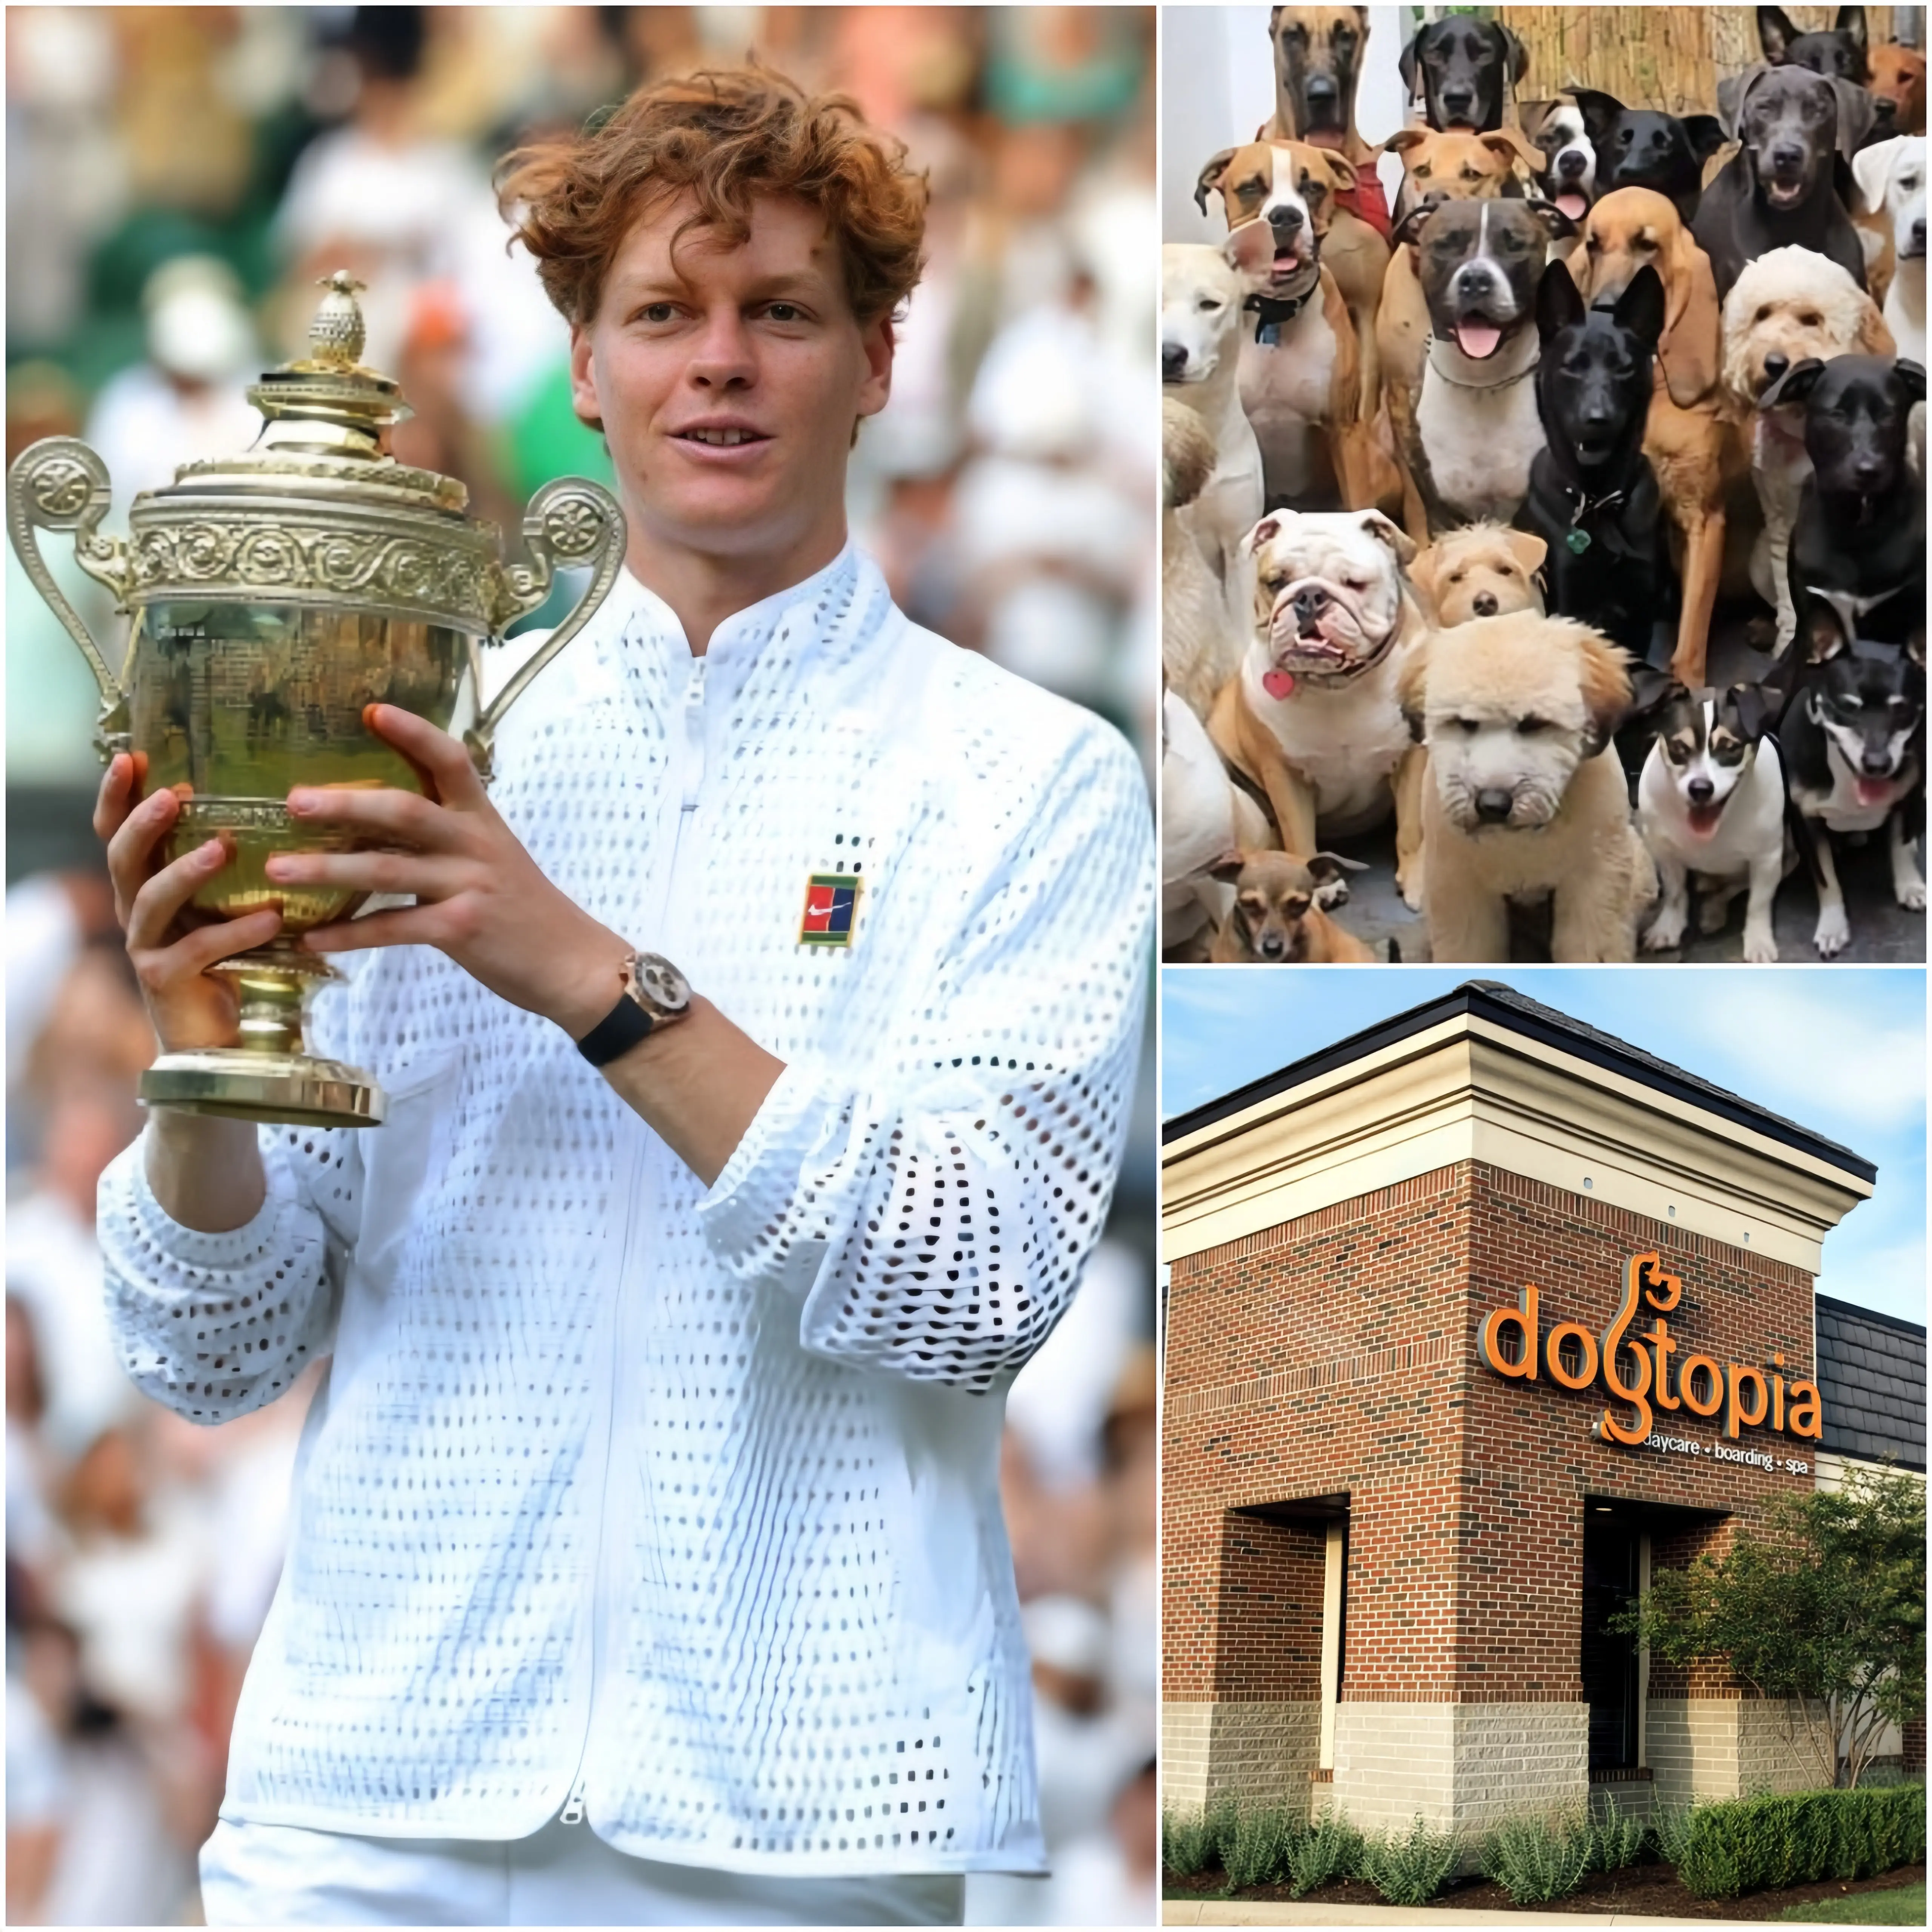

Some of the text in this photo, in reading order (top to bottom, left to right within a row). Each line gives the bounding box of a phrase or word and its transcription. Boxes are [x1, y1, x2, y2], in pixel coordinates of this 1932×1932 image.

[1478, 1251, 1823, 1444] dogtopia
[1715, 1441, 1774, 1472] boarding
[1786, 1459, 1808, 1475] spa
